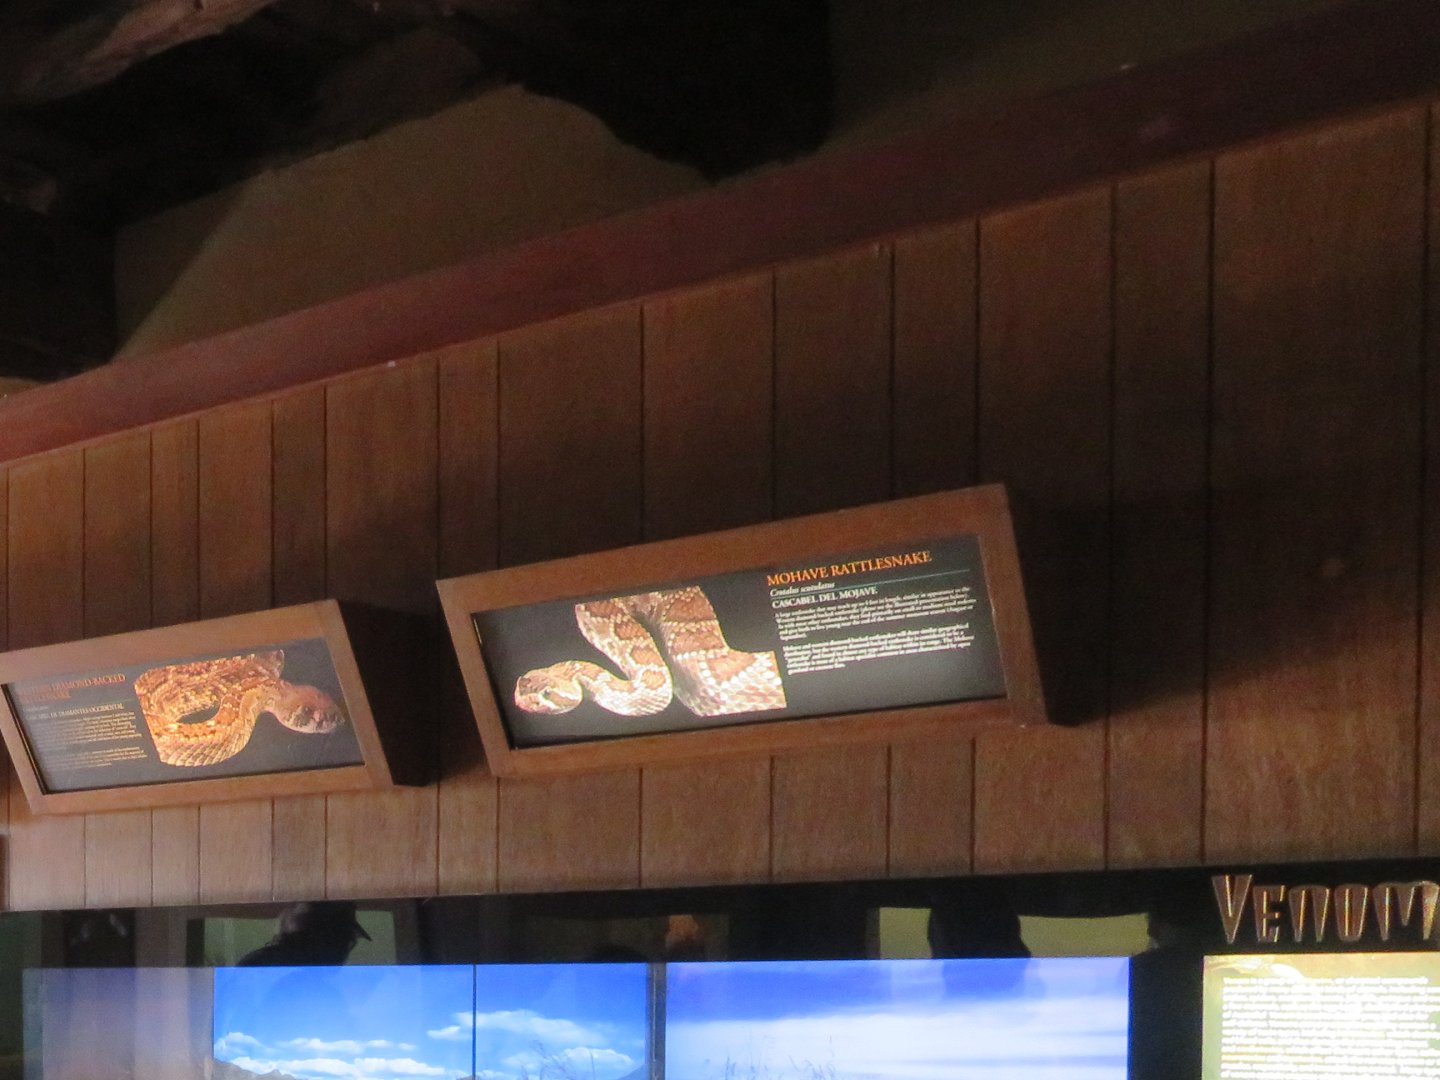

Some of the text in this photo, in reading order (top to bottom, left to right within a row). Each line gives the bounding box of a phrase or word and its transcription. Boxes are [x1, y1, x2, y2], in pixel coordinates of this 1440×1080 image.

[766, 550, 933, 586] MOHAVE RATTLESNAKE
[772, 586, 879, 609] CASCABEL DEL MOJAVE
